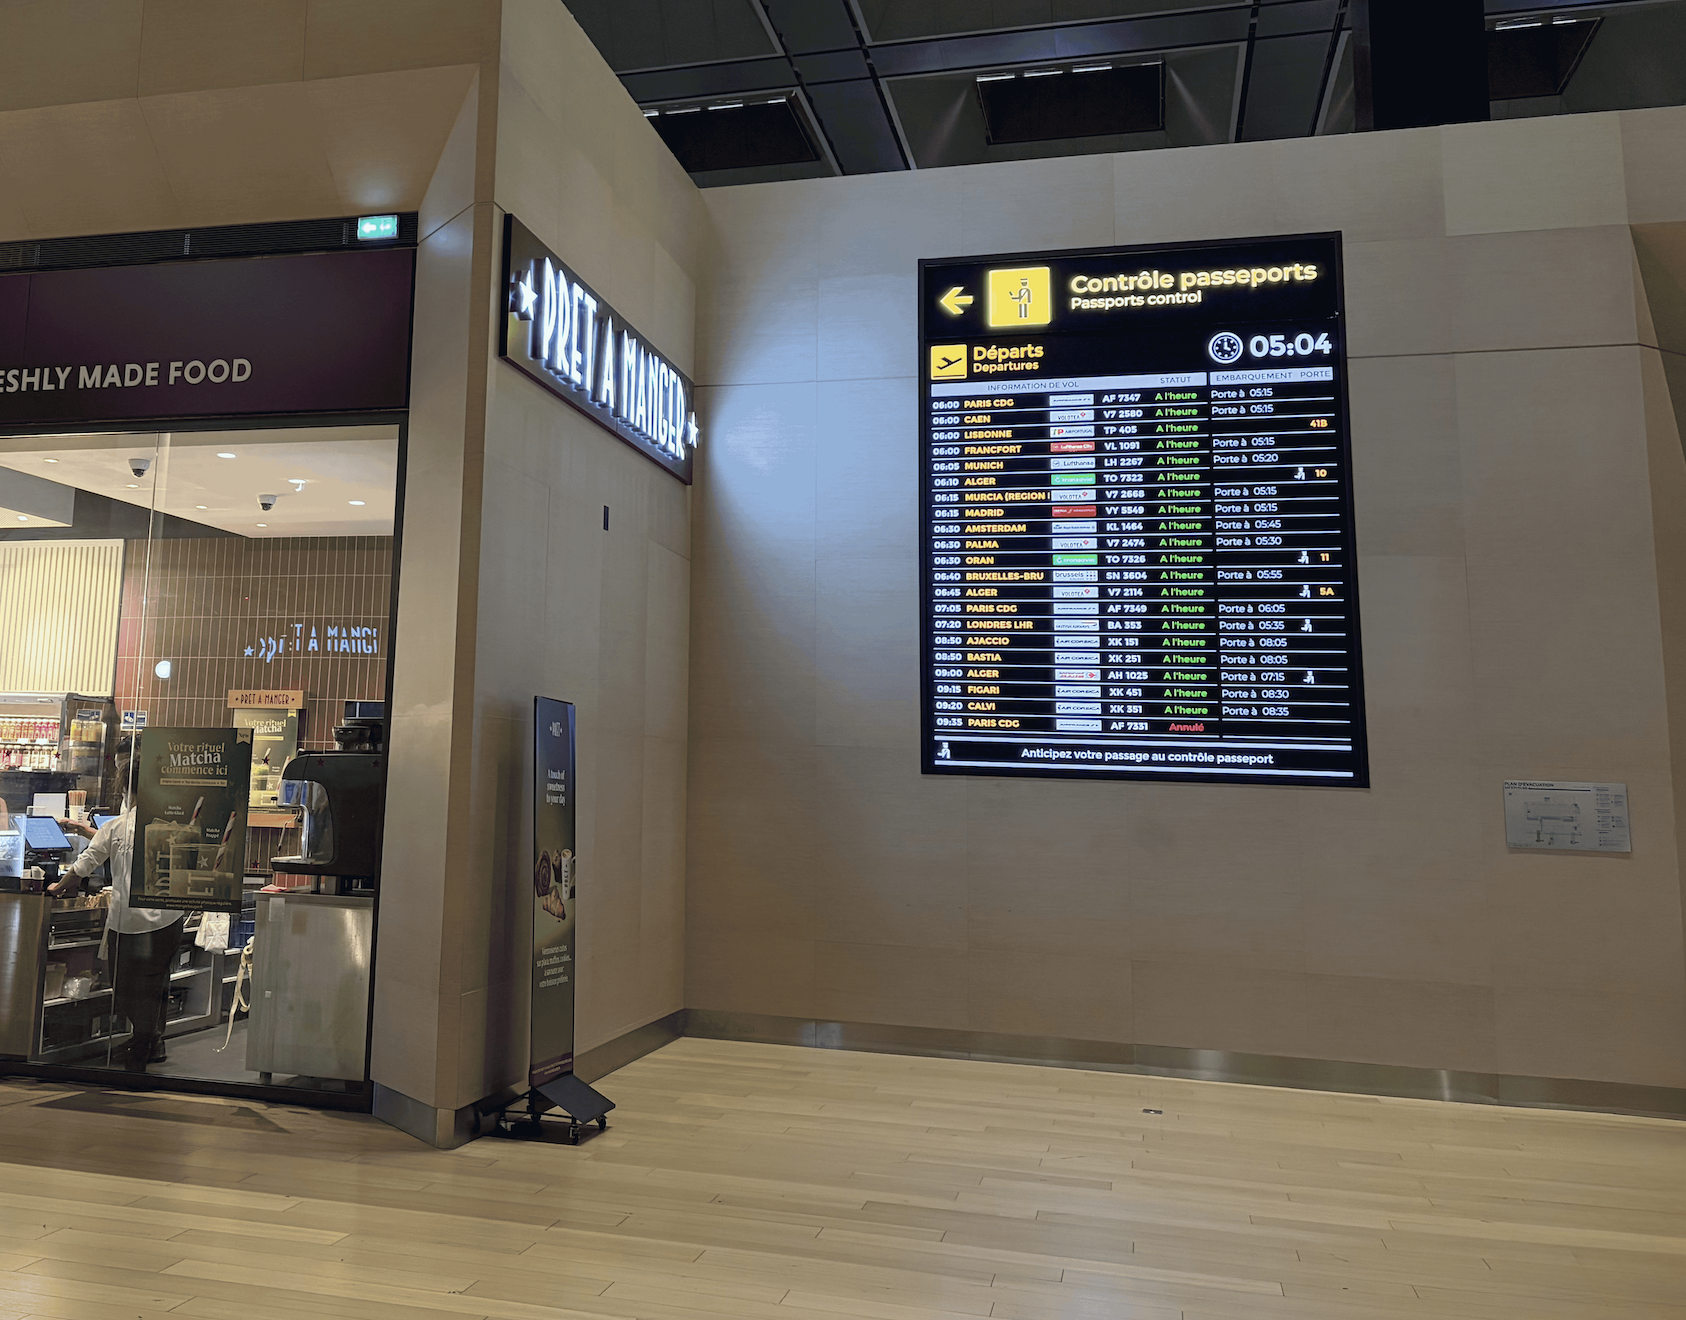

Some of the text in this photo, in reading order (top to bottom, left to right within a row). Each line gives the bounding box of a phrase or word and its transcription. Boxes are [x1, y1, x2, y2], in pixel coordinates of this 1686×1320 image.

[1071, 263, 1317, 294] Contrôle passeports
[1071, 290, 1202, 309] Passports control
[1250, 333, 1332, 357] 05:04
[542, 257, 686, 460] PRET A MANGER
[973, 344, 1044, 362] Départs
[78, 362, 159, 389] MADE
[168, 358, 252, 385] FOOD
[973, 361, 1039, 374] Departures
[987, 382, 1047, 390] INFORMATION
[1216, 371, 1292, 381] EMBARQUEMENT
[932, 387, 1273, 410] 06:00 PARIS CDG AF 7347 A l'heure Porte à 05:15
[932, 416, 960, 425] 06:00
[964, 414, 990, 423] CAEN
[1103, 410, 1116, 418] V7
[1118, 409, 1142, 418] 2580
[932, 418, 1328, 440] 06:00 LISBONNE TP 405 41B
[932, 446, 960, 456] 06:00
[964, 445, 1021, 454] FRANCFORT
[1104, 442, 1116, 450] VL
[1119, 441, 1140, 450] 1091
[932, 462, 960, 471] 06:05
[964, 461, 1003, 470] MUNICH
[1104, 458, 1117, 466] LH
[1119, 457, 1143, 466] 2267
[1166, 455, 1199, 464] l'heure
[1213, 454, 1240, 463] Porte
[1241, 454, 1247, 462] à
[1252, 453, 1278, 462] 05:20
[934, 469, 1326, 486] 06:10 ALGER TO 7322 10
[934, 493, 959, 502] 06:15
[965, 492, 1003, 502] MURCIA
[1004, 491, 1045, 501] (REGION
[1105, 490, 1118, 498] V7
[1120, 489, 1144, 498] 2668
[934, 509, 959, 517] 06:15
[965, 508, 1004, 517] MADRID
[1105, 506, 1118, 514] VY
[1120, 505, 1144, 514] 5549
[933, 522, 1143, 533] 06:30 AMSTERDAM KL 1464
[933, 540, 960, 549] 06:30
[965, 540, 998, 548] PALMA
[1106, 538, 1119, 547] V7
[1121, 538, 1144, 547] 2474
[934, 553, 1329, 564] 06:30 ORAN TO 7326 11
[934, 572, 961, 580] 06:40
[966, 572, 1043, 580] BRUXELLES-BRU
[1106, 571, 1120, 579] SN
[1122, 571, 1147, 579] 3604
[934, 588, 960, 596] 06:45
[966, 588, 997, 596] ALGER
[1107, 588, 1120, 596] V7
[1123, 588, 1142, 596] 2114
[1319, 587, 1334, 595] 5A
[934, 604, 1147, 612] 07:05 PARIS CDG AF 7349
[934, 620, 961, 628] 07:20
[934, 636, 962, 644] 08:50
[935, 652, 1001, 661] 08:50 BASTIA
[934, 668, 998, 677] 09:00 ALGER
[936, 684, 999, 694] 09:15 FIGARI
[241, 694, 256, 705] PRET
[264, 694, 290, 705] MANGER
[935, 700, 995, 710] 09:20 CALVI
[245, 719, 286, 728] Votre rituel
[936, 717, 1204, 731] 09:35 PARIS CDG Annulé
[168, 742, 225, 752] Votre rituel
[170, 750, 221, 767] Matcha
[1021, 748, 1273, 765] Anticipez votre passage au contrôle passeport
[161, 765, 228, 775] commence ici
